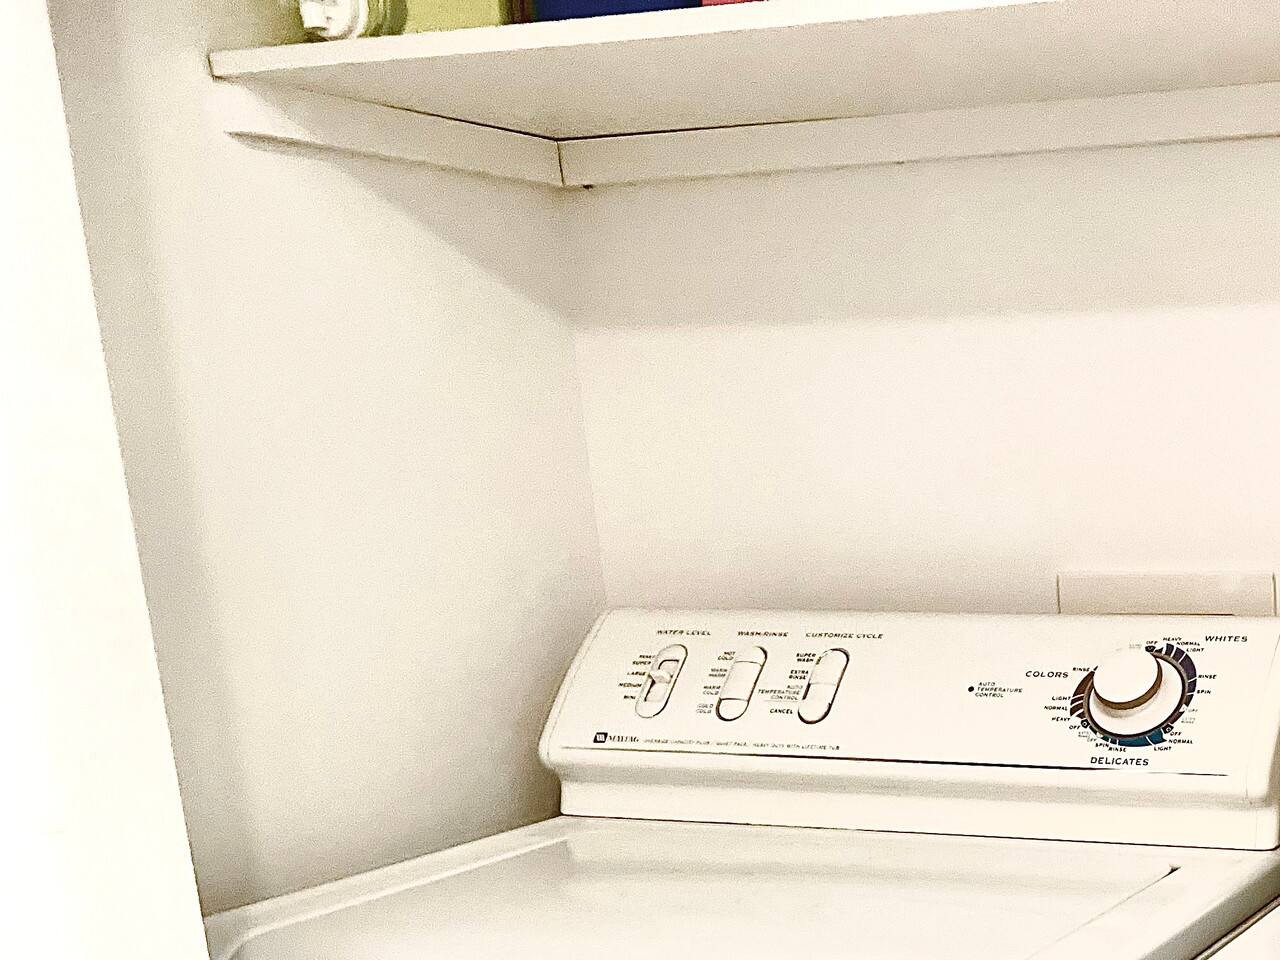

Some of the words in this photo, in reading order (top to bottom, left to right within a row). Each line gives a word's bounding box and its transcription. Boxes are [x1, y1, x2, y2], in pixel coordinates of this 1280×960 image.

[1205, 635, 1248, 643] WHITES
[1025, 670, 1069, 679] COLORS
[1090, 756, 1150, 766] DELICATES
